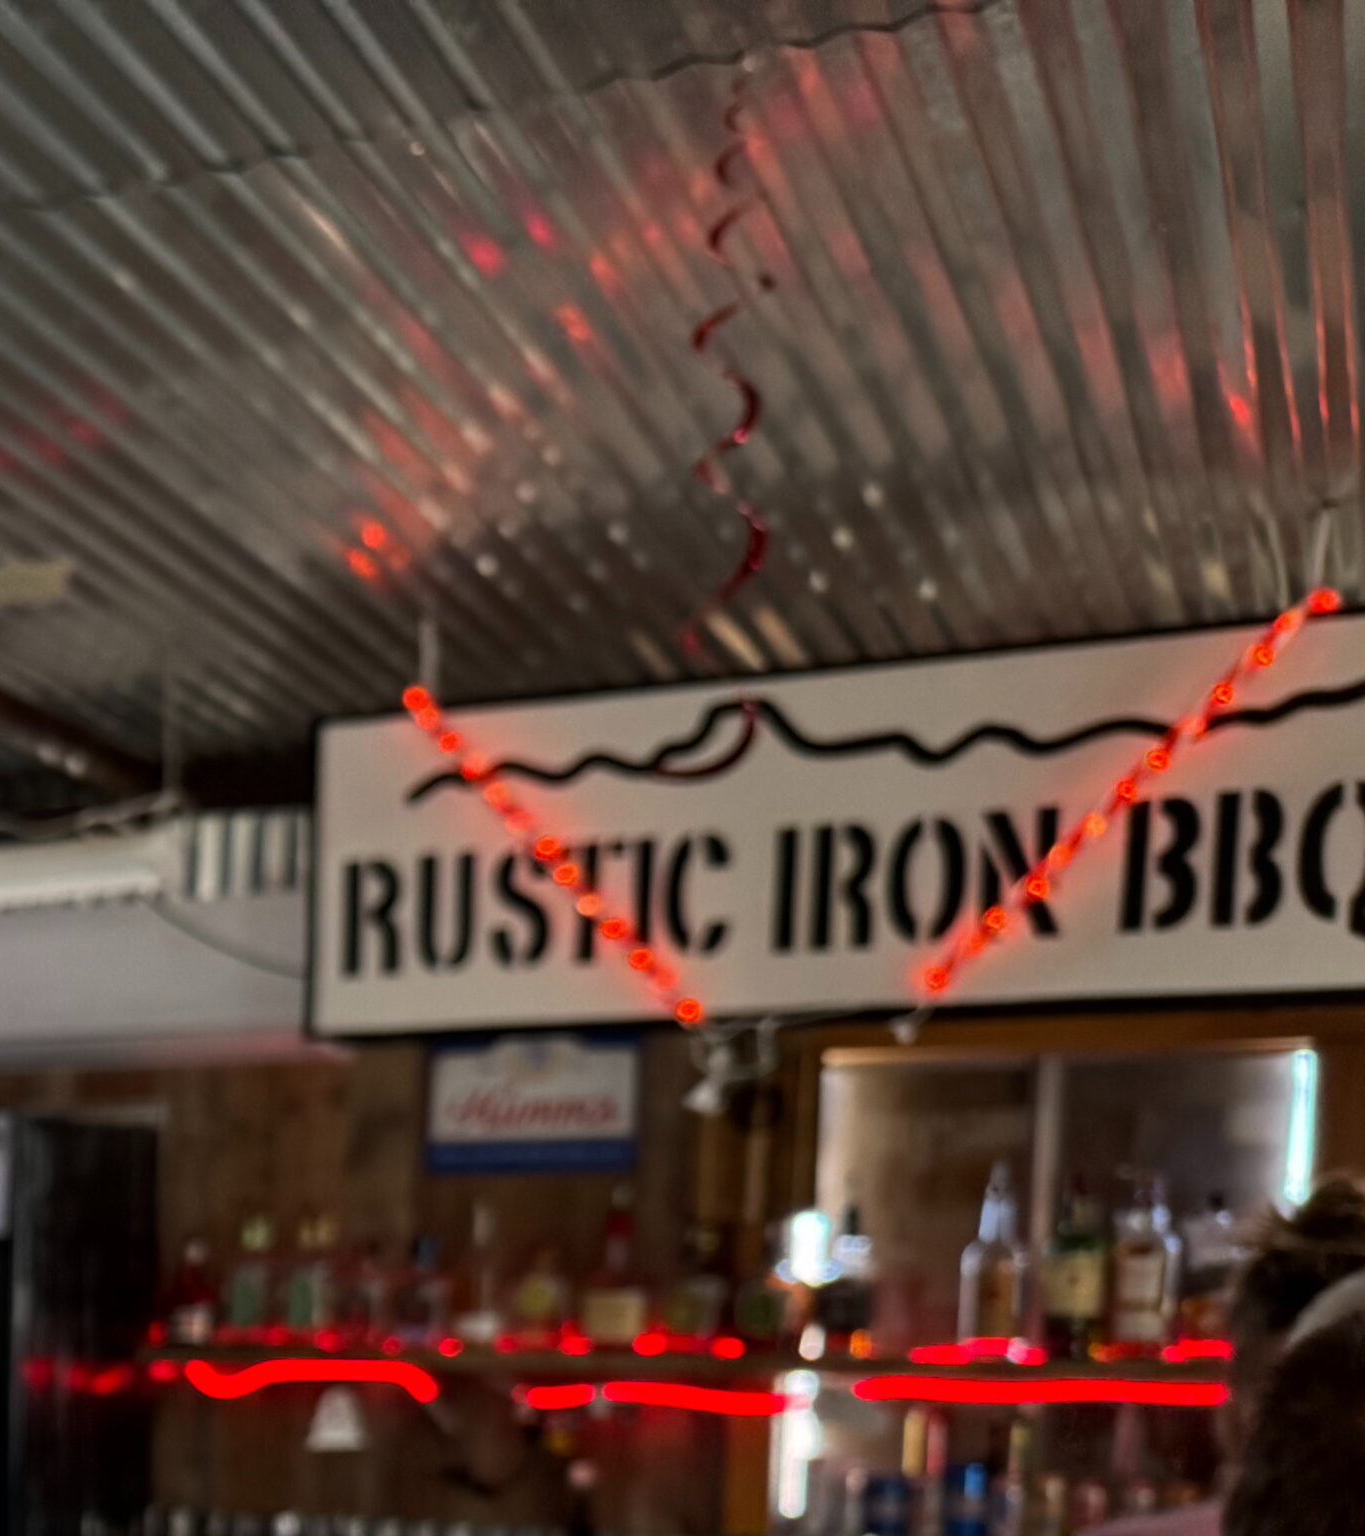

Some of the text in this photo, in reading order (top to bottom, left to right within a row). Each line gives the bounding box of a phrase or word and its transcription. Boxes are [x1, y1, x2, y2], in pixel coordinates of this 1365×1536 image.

[341, 781, 1365, 979] RUSTIC IRON BBQ
